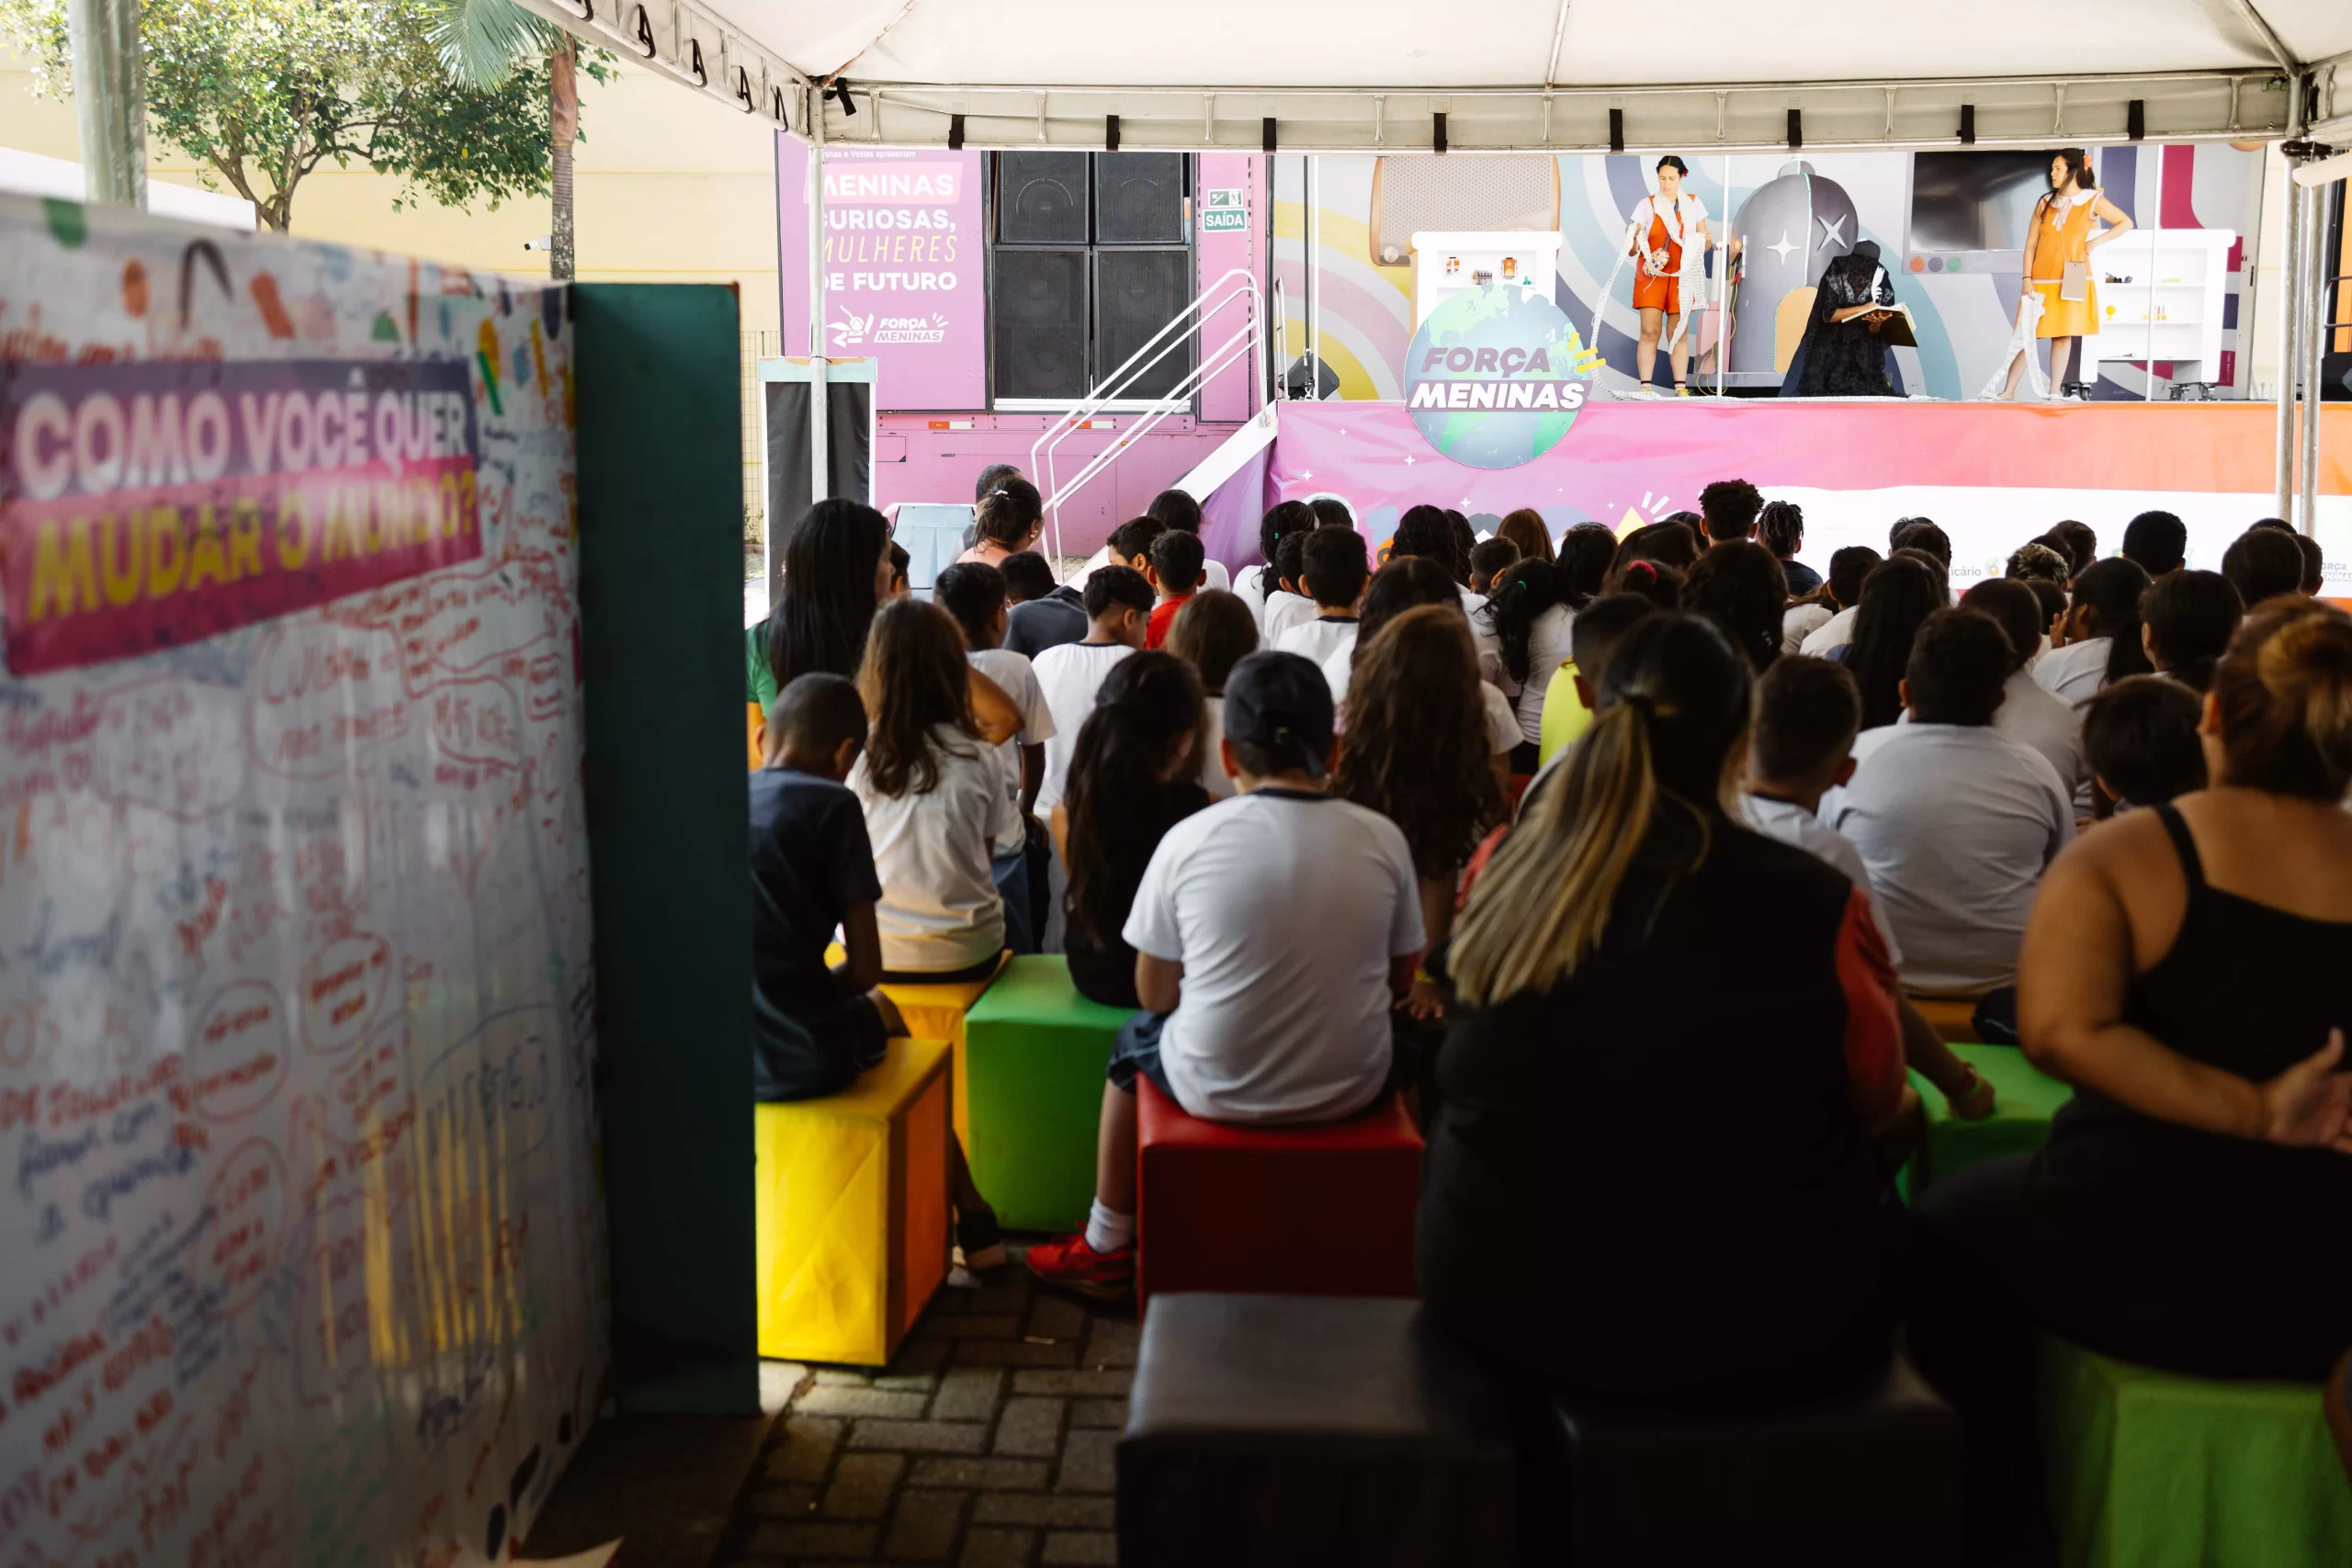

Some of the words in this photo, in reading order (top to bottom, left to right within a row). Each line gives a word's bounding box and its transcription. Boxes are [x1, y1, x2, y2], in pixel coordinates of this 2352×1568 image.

[851, 150, 874, 158] Vestas
[876, 151, 916, 159] apresentam
[824, 209, 956, 232] URIOSAS,
[1205, 211, 1243, 227] SAÍDA
[825, 272, 845, 290] E
[853, 272, 957, 290] FUTURO
[879, 318, 927, 330] FORÇA
[876, 332, 941, 343] MENINAS
[1421, 347, 1551, 378] FORÇA
[1409, 382, 1585, 409] MENINAS
[14, 389, 230, 499] COMO
[240, 367, 368, 476] VOCÊ
[375, 389, 469, 476] QUER
[28, 496, 264, 624] MUDAR
[277, 488, 311, 571] O
[1949, 566, 1982, 577] icário
